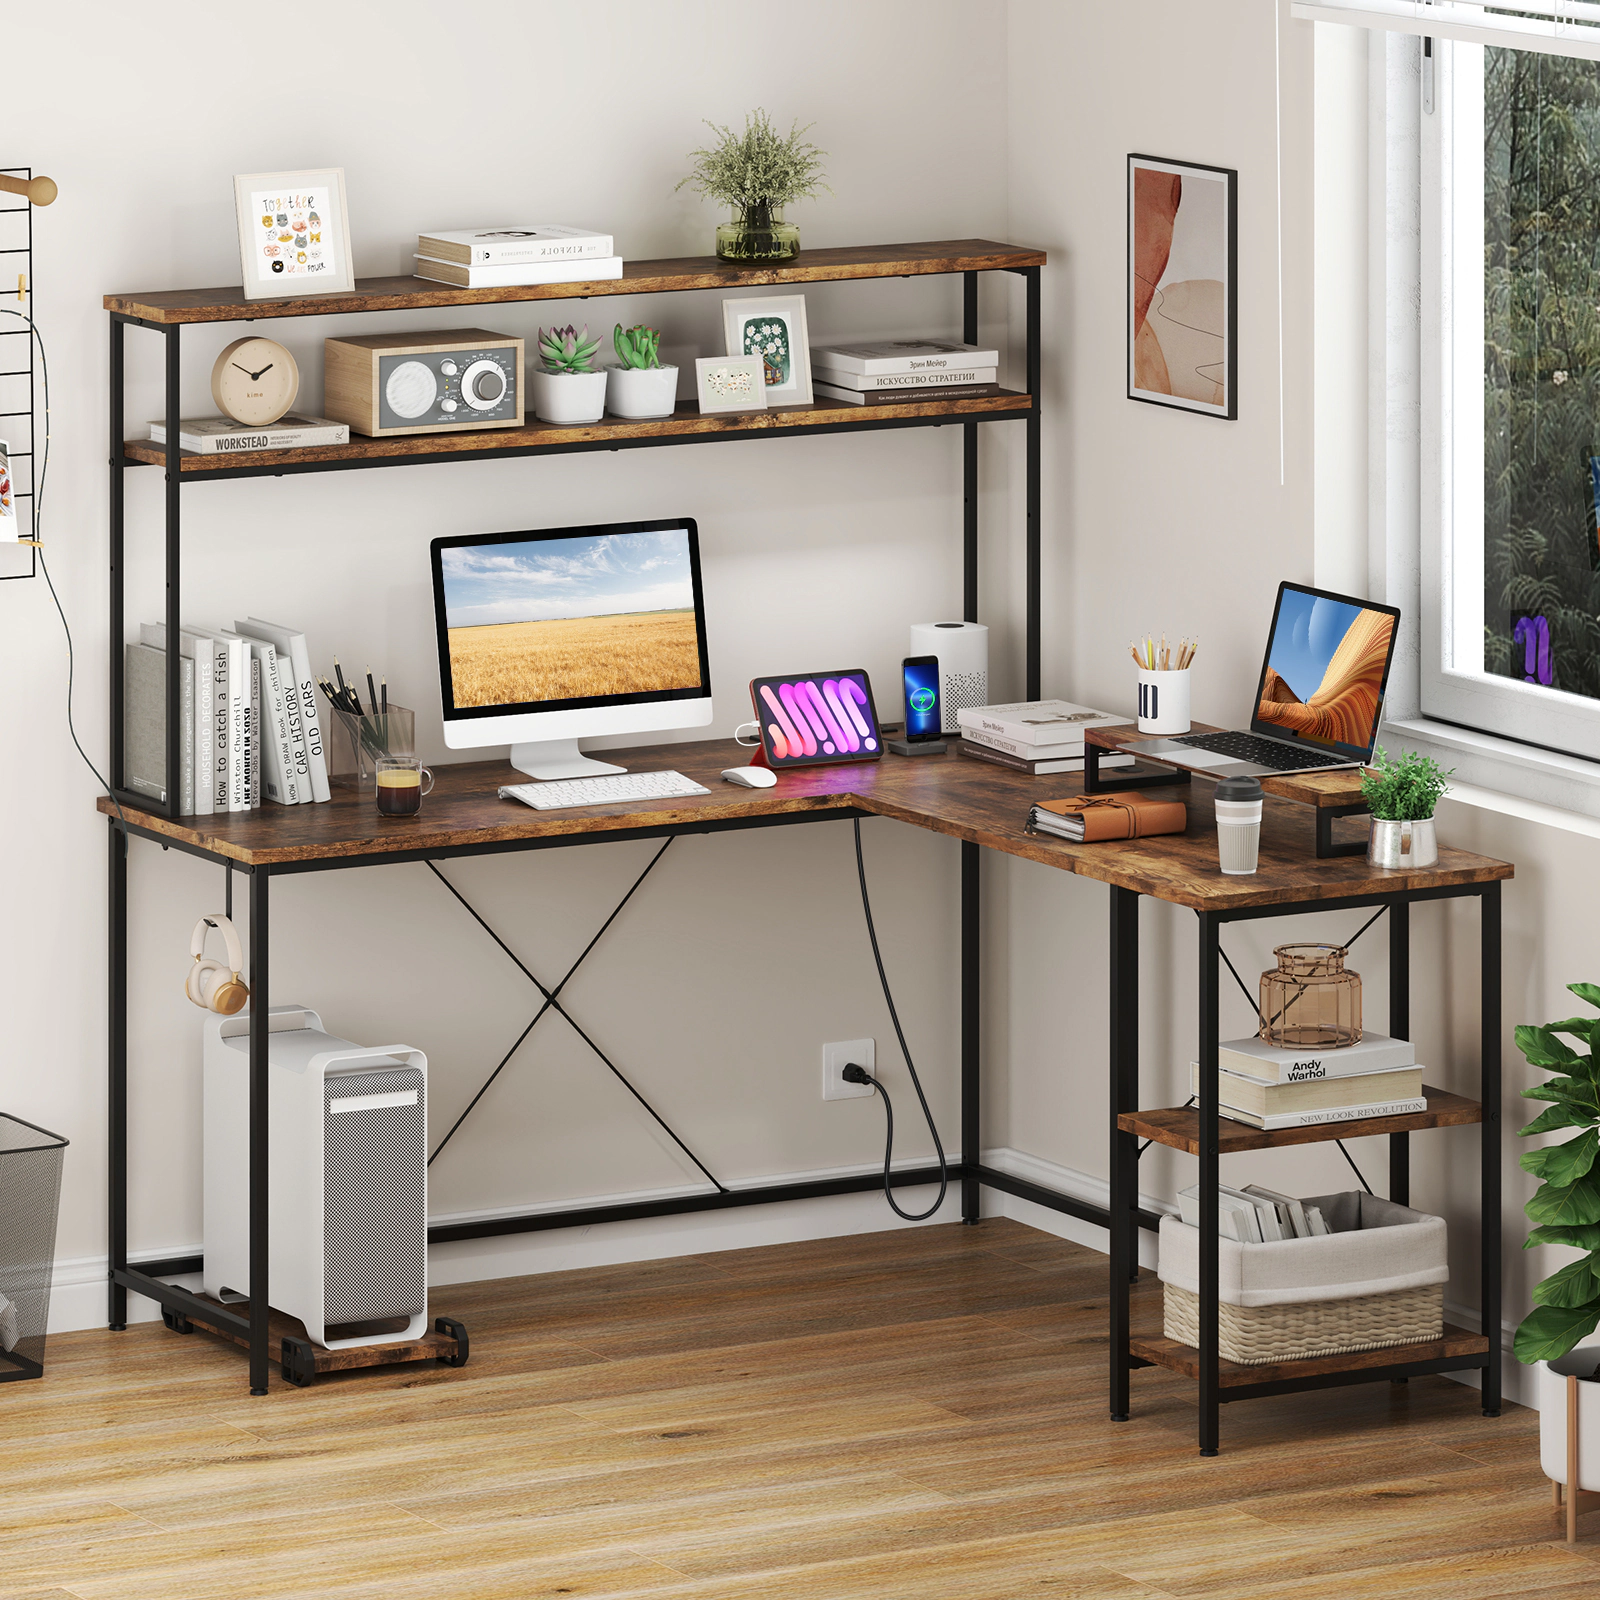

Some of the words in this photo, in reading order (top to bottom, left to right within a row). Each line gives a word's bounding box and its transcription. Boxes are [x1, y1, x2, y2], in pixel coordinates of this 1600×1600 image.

[926, 359, 947, 368] Мейер
[876, 375, 927, 386] ИСКУССТВО
[928, 373, 975, 382] СТРАТЕГИИ
[215, 435, 268, 451] WORKSTEAD
[215, 652, 227, 684] fish
[267, 649, 279, 692] children
[202, 662, 211, 722] DECORATES
[218, 692, 227, 700] a
[300, 680, 316, 719] CARS
[284, 686, 303, 744] HISTORY
[216, 708, 227, 749] catch
[278, 717, 287, 739] Book
[252, 740, 260, 751] by
[308, 726, 323, 756] OLD
[186, 756, 191, 765] an
[202, 728, 211, 788] HOUSEHOLD
[282, 742, 291, 765] DRAW
[295, 749, 308, 775] CAR
[216, 757, 227, 773] to
[286, 768, 293, 780] TO
[185, 785, 191, 795] to
[216, 781, 227, 806] How
[289, 783, 297, 801] HOW
[1287, 1068, 1326, 1082] Warhol
[1292, 1059, 1322, 1071] Andy
[1300, 1114, 1324, 1124] NEW
[1326, 1110, 1354, 1121] LOOK
[1357, 1102, 1423, 1118] REVOLUTION
